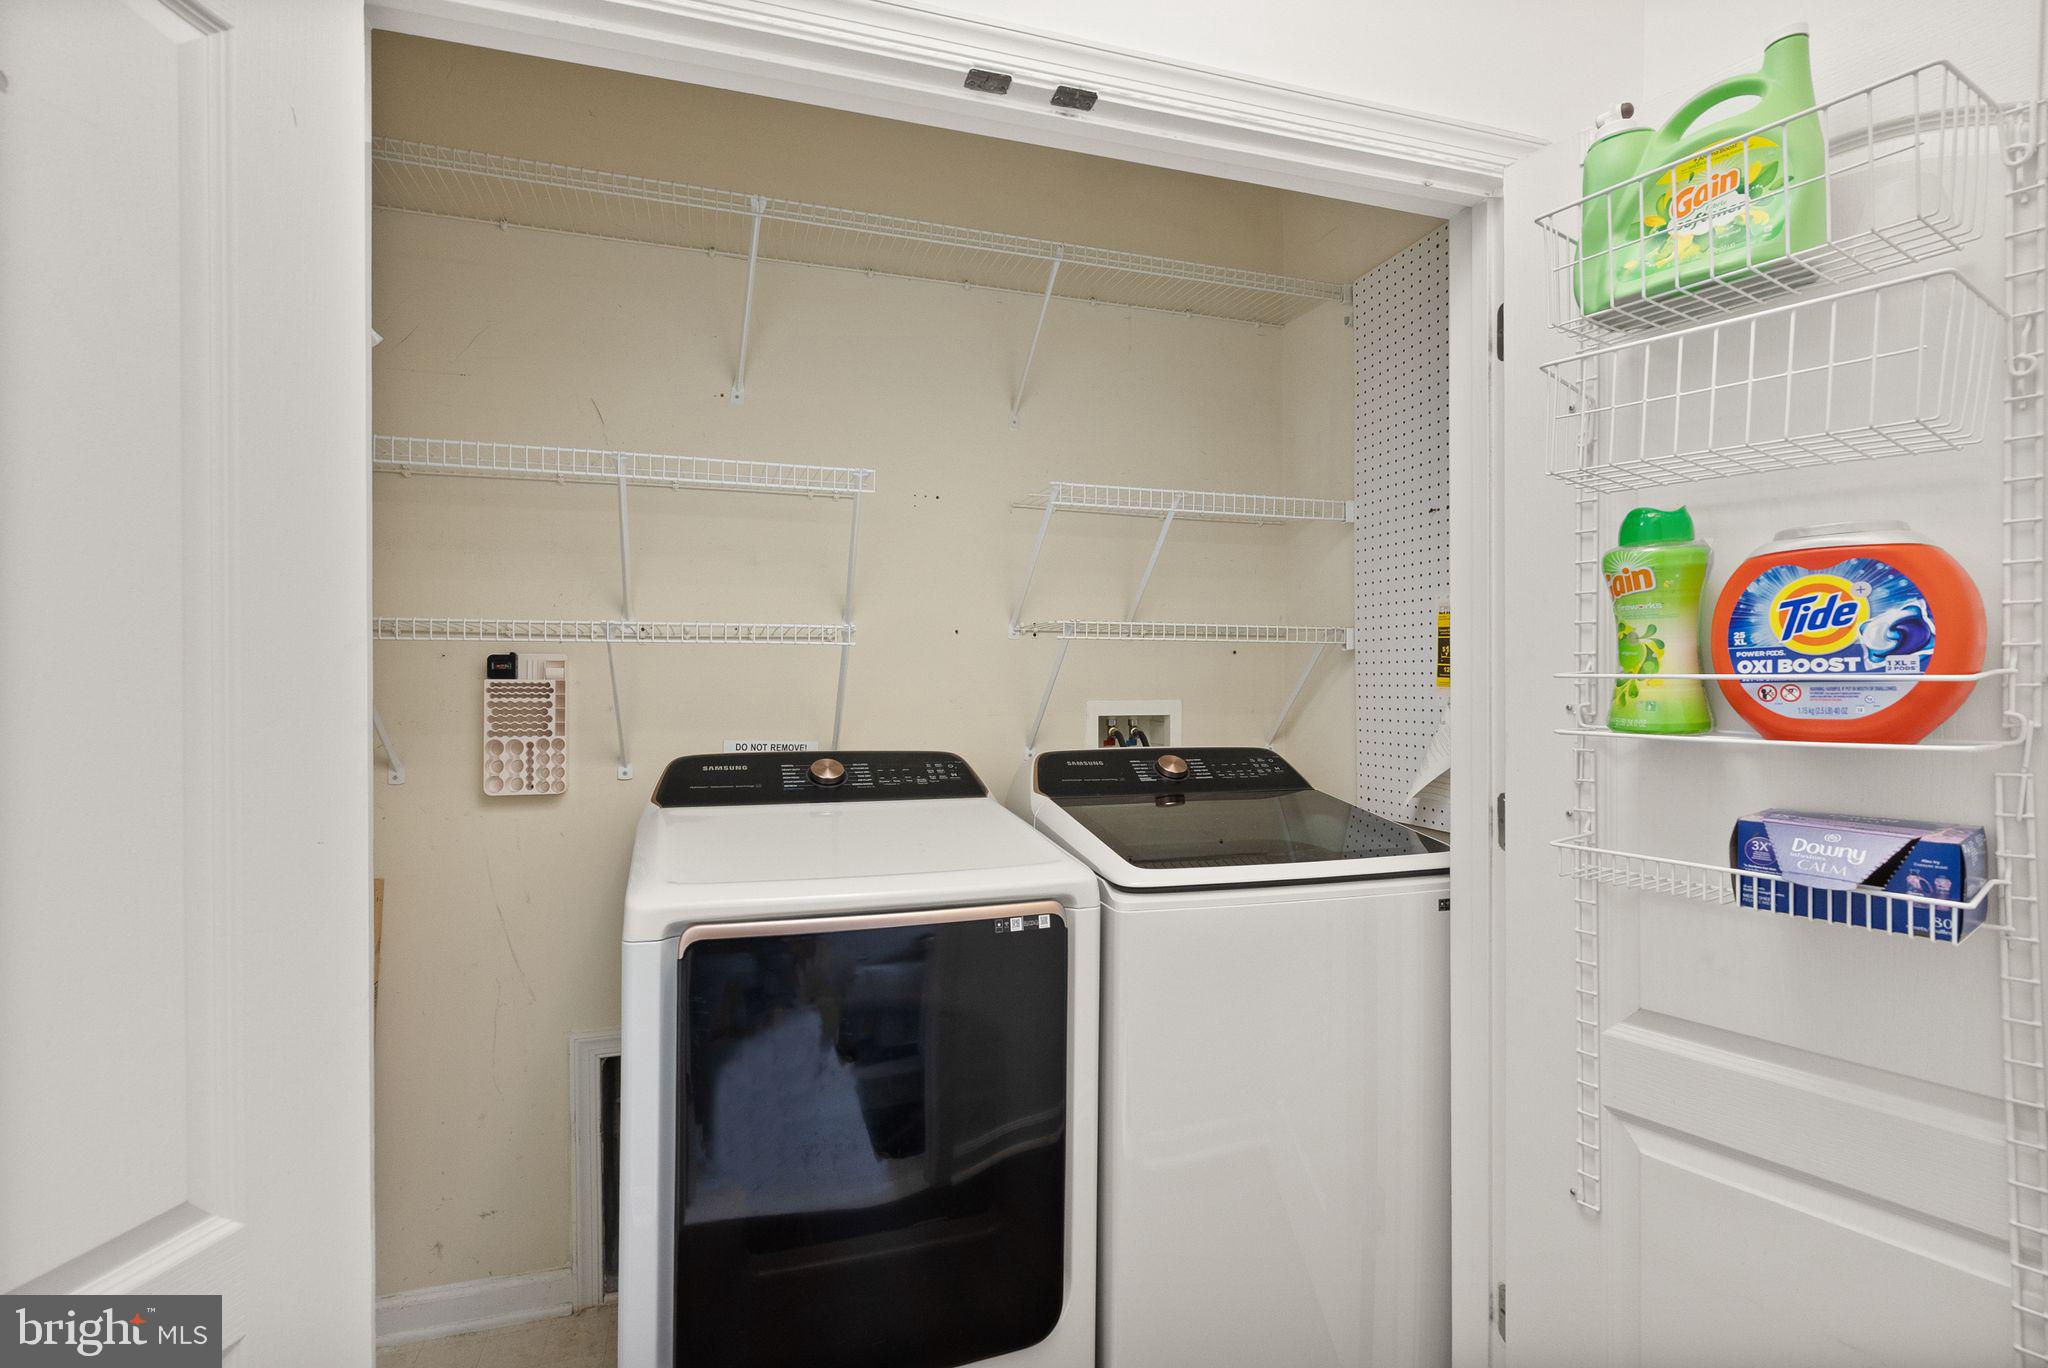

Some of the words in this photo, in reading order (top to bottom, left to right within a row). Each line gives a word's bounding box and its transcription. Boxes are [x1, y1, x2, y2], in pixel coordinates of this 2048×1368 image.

[1670, 168, 1740, 220] Gain
[1779, 593, 1859, 642] Tide
[1736, 650, 1765, 658] POWER
[1737, 659, 1773, 674] OXI
[1778, 656, 1861, 674] BOOST
[735, 743, 748, 751] DO
[750, 743, 768, 751] NOT
[770, 743, 808, 752] REMOVE!
[702, 764, 748, 772] SAMSUNG
[1792, 837, 1867, 866] Downy
[1797, 859, 1847, 877] CALM
